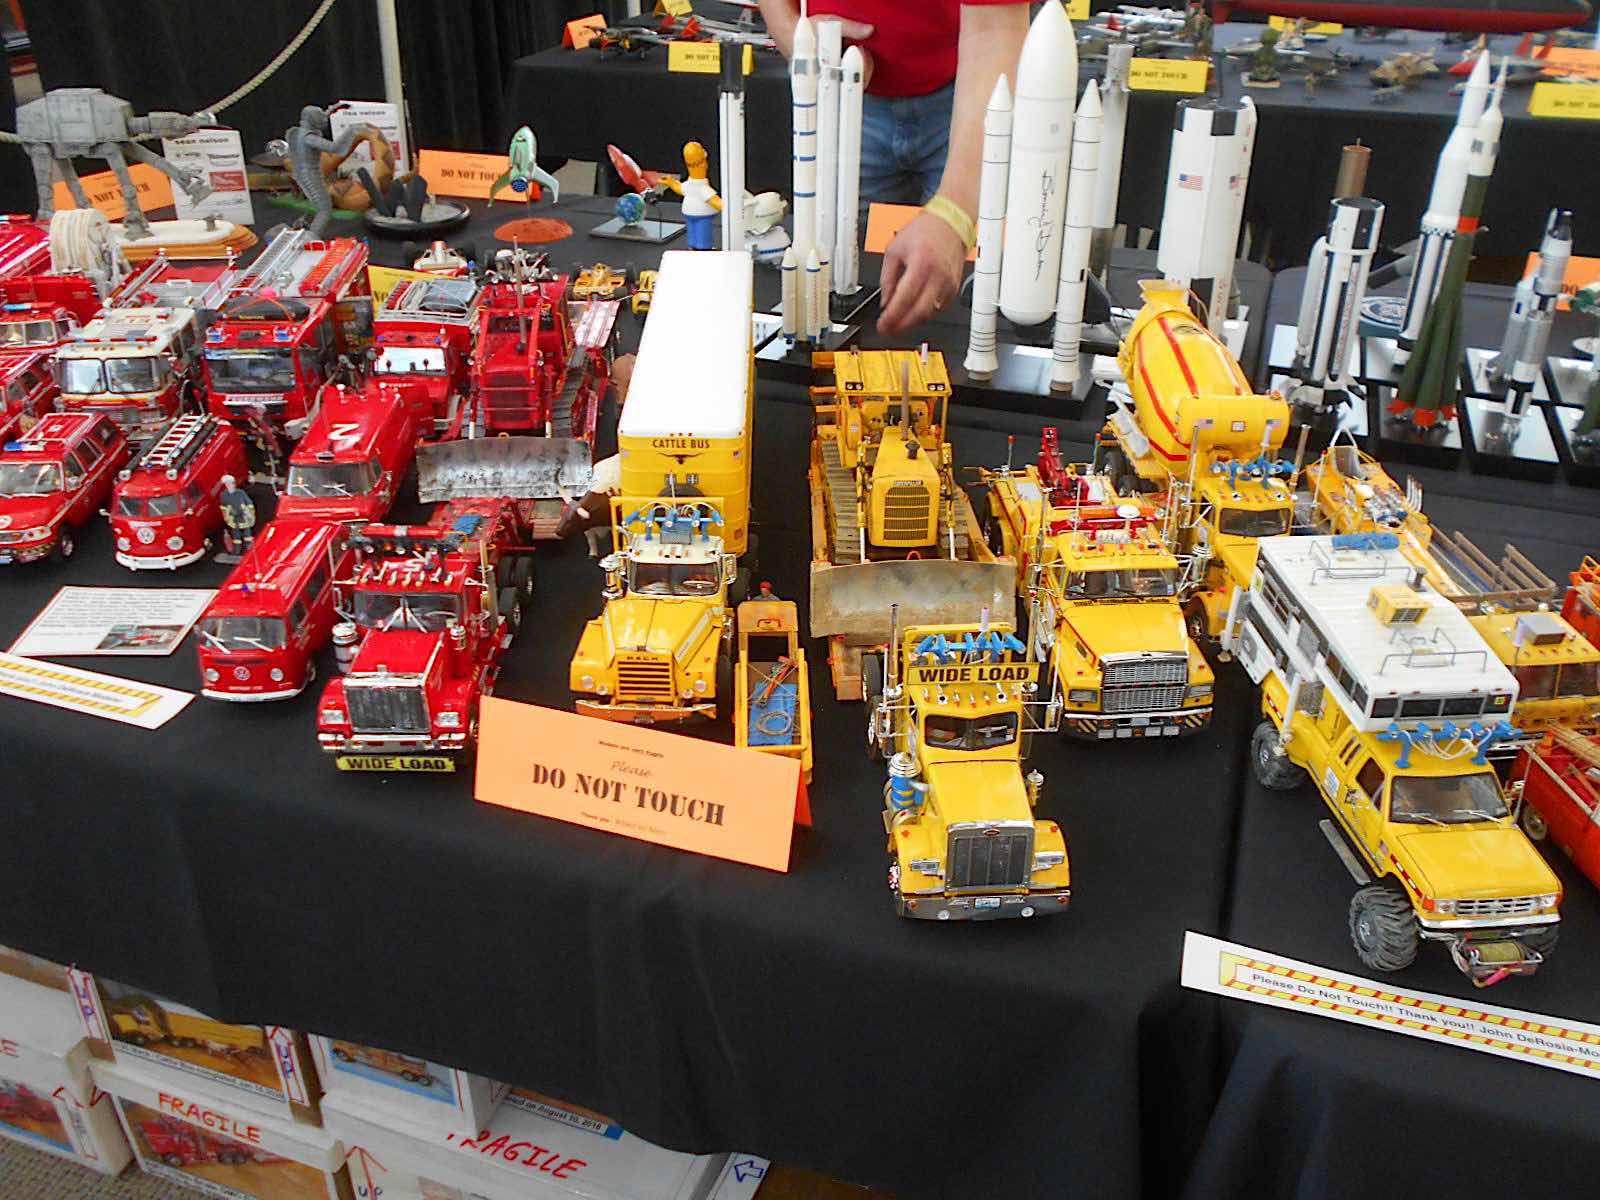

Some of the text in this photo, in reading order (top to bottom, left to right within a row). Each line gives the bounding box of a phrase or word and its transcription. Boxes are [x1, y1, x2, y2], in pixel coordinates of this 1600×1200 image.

[441, 168, 454, 178] DO
[458, 170, 475, 181] NOT
[94, 191, 115, 203] NOT
[652, 439, 710, 449] CATTLE BUS
[919, 666, 1030, 683] WIDE LOAD
[345, 757, 447, 770] WIDE LOAD
[611, 760, 652, 778] Please
[532, 763, 566, 790] DO
[573, 772, 628, 804] NOT
[634, 785, 726, 828] TOUCH
[1251, 973, 1295, 990] Please
[1297, 984, 1315, 995] Do
[1318, 990, 1341, 1001] Not
[1344, 995, 1393, 1012] Touch!!
[1398, 1007, 1438, 1023] Thank
[1479, 1025, 1513, 1040] John
[158, 1092, 261, 1143] FRAGILE
[446, 1129, 588, 1179] RAGILE
